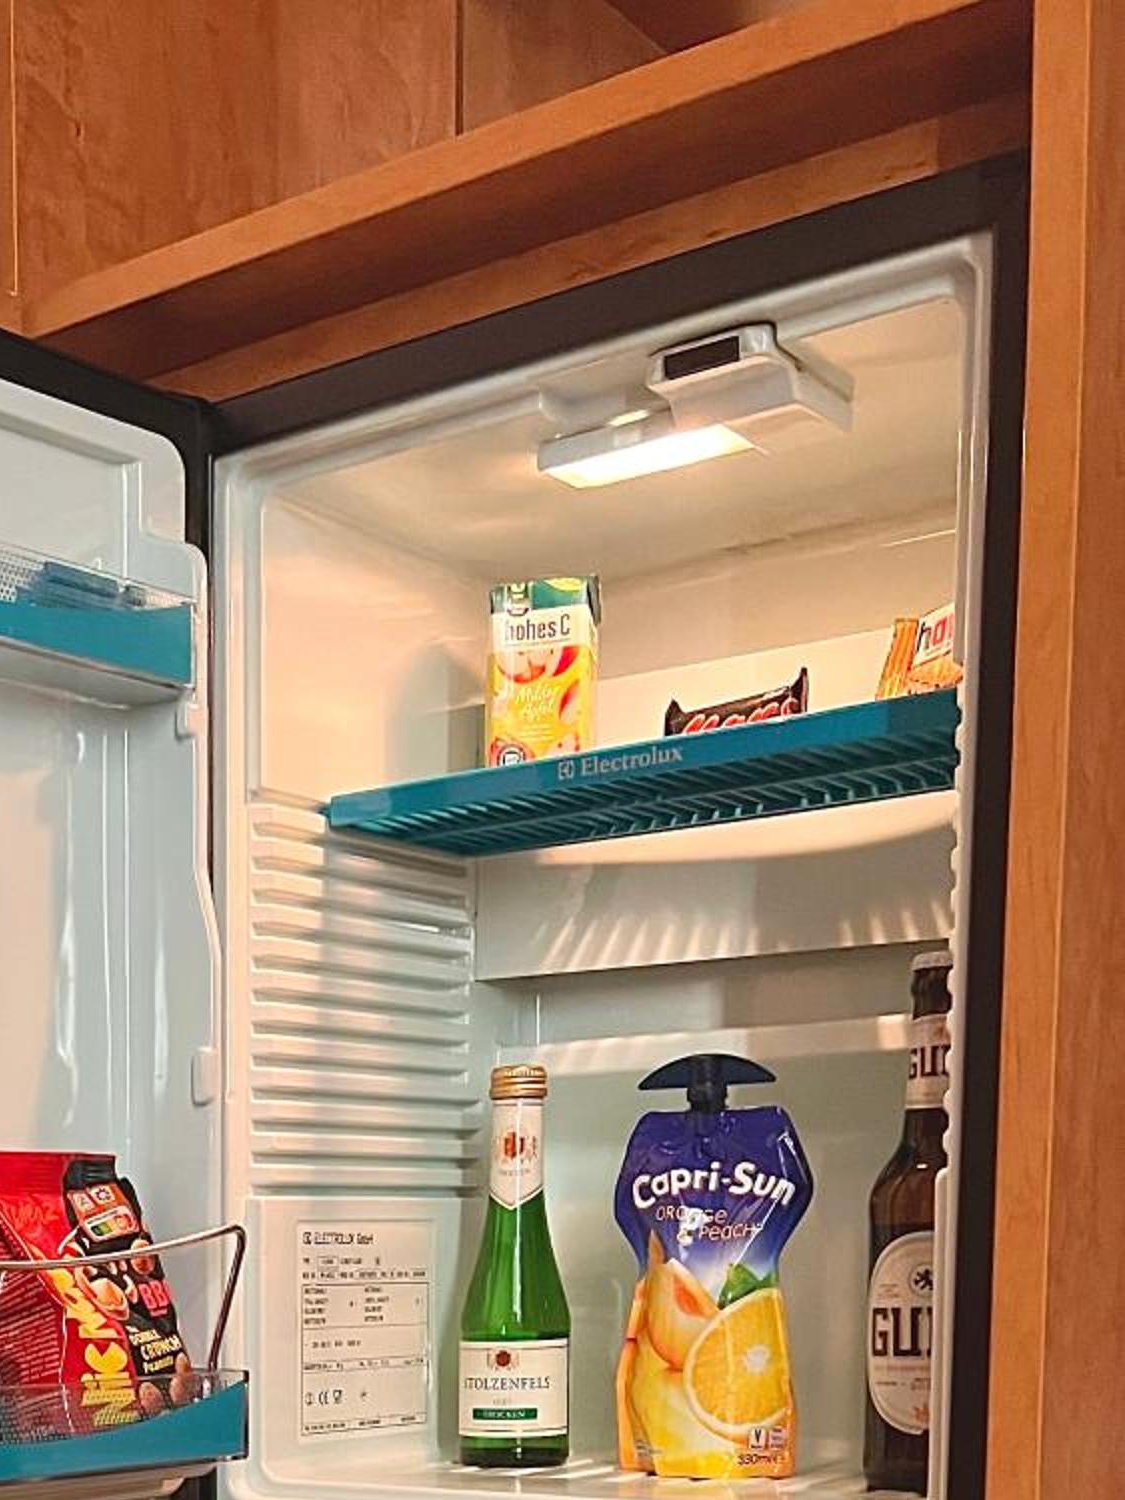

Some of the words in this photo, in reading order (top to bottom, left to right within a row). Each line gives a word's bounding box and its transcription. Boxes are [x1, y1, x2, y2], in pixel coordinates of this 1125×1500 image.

[505, 618, 556, 641] hohes
[559, 613, 571, 636] C
[580, 745, 683, 775] Electrolux
[632, 1160, 796, 1210] Capri-Sun
[872, 1307, 933, 1358] GU
